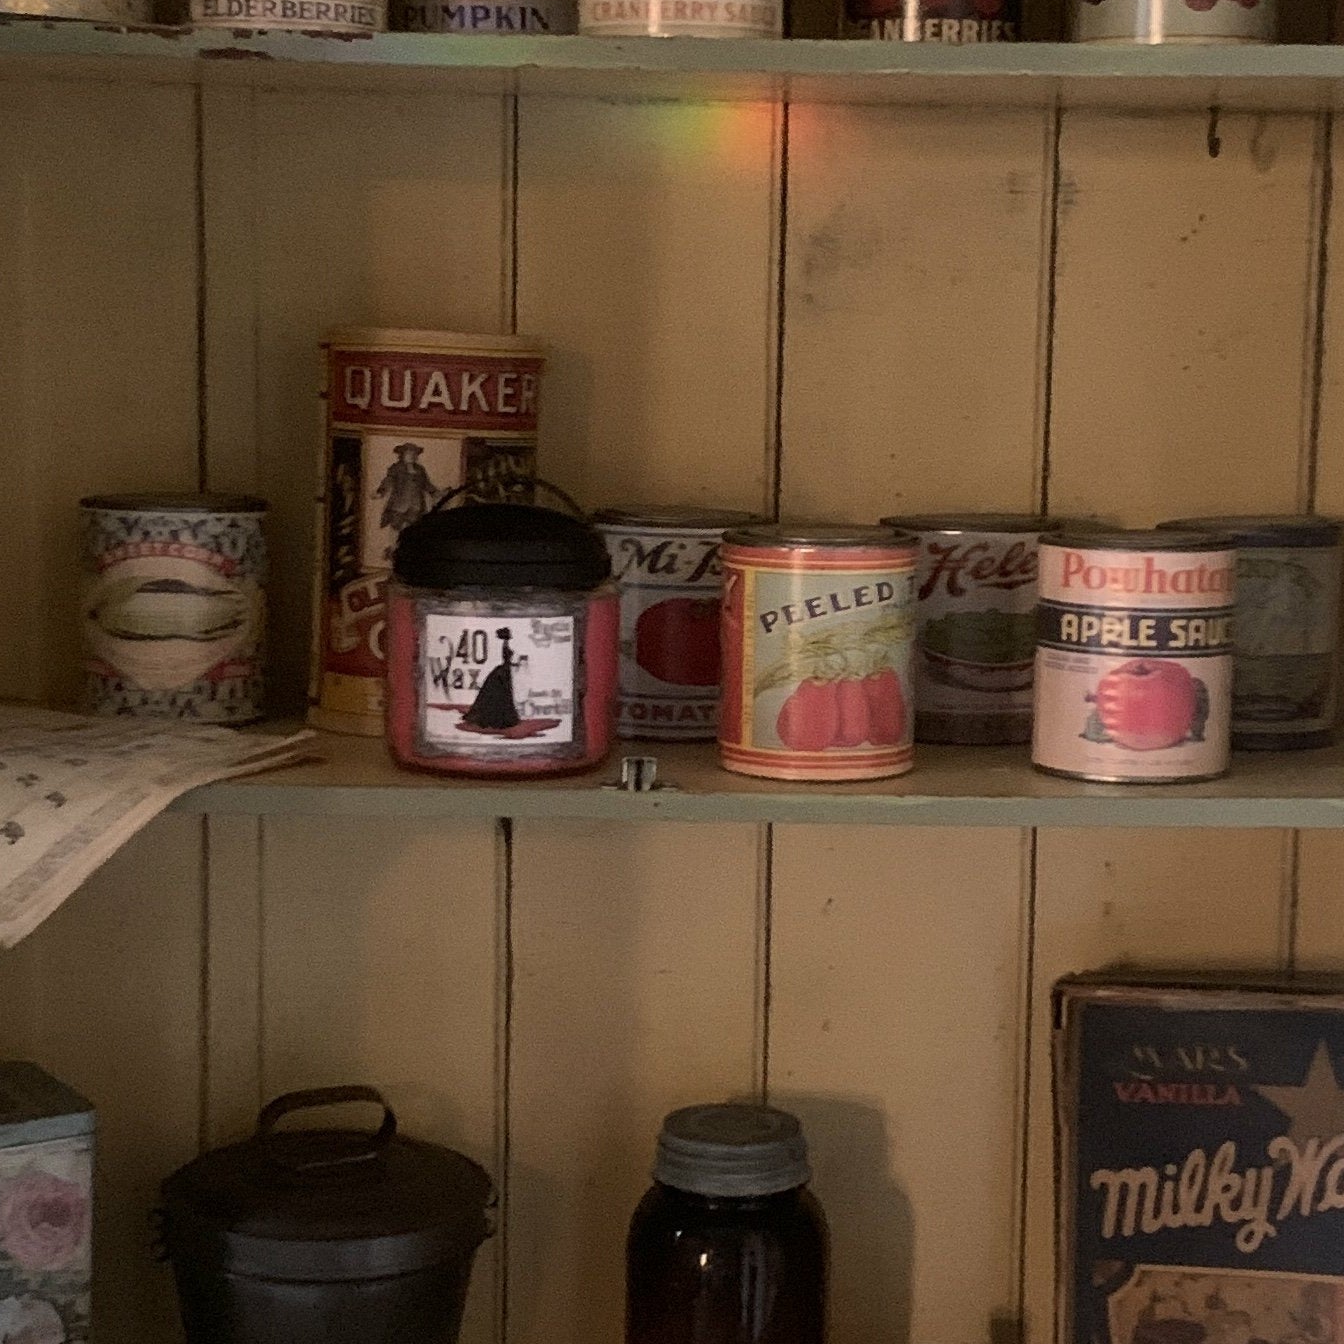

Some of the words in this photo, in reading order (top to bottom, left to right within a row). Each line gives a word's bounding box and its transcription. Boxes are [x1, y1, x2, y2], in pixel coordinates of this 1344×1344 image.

[404, 3, 549, 31] PUMPKIN
[344, 366, 537, 414] QUAKER
[759, 581, 895, 634] PEELED
[1060, 611, 1158, 647] APPLE
[1112, 1082, 1245, 1106] VANILLA
[1090, 1141, 1278, 1253] Milky
